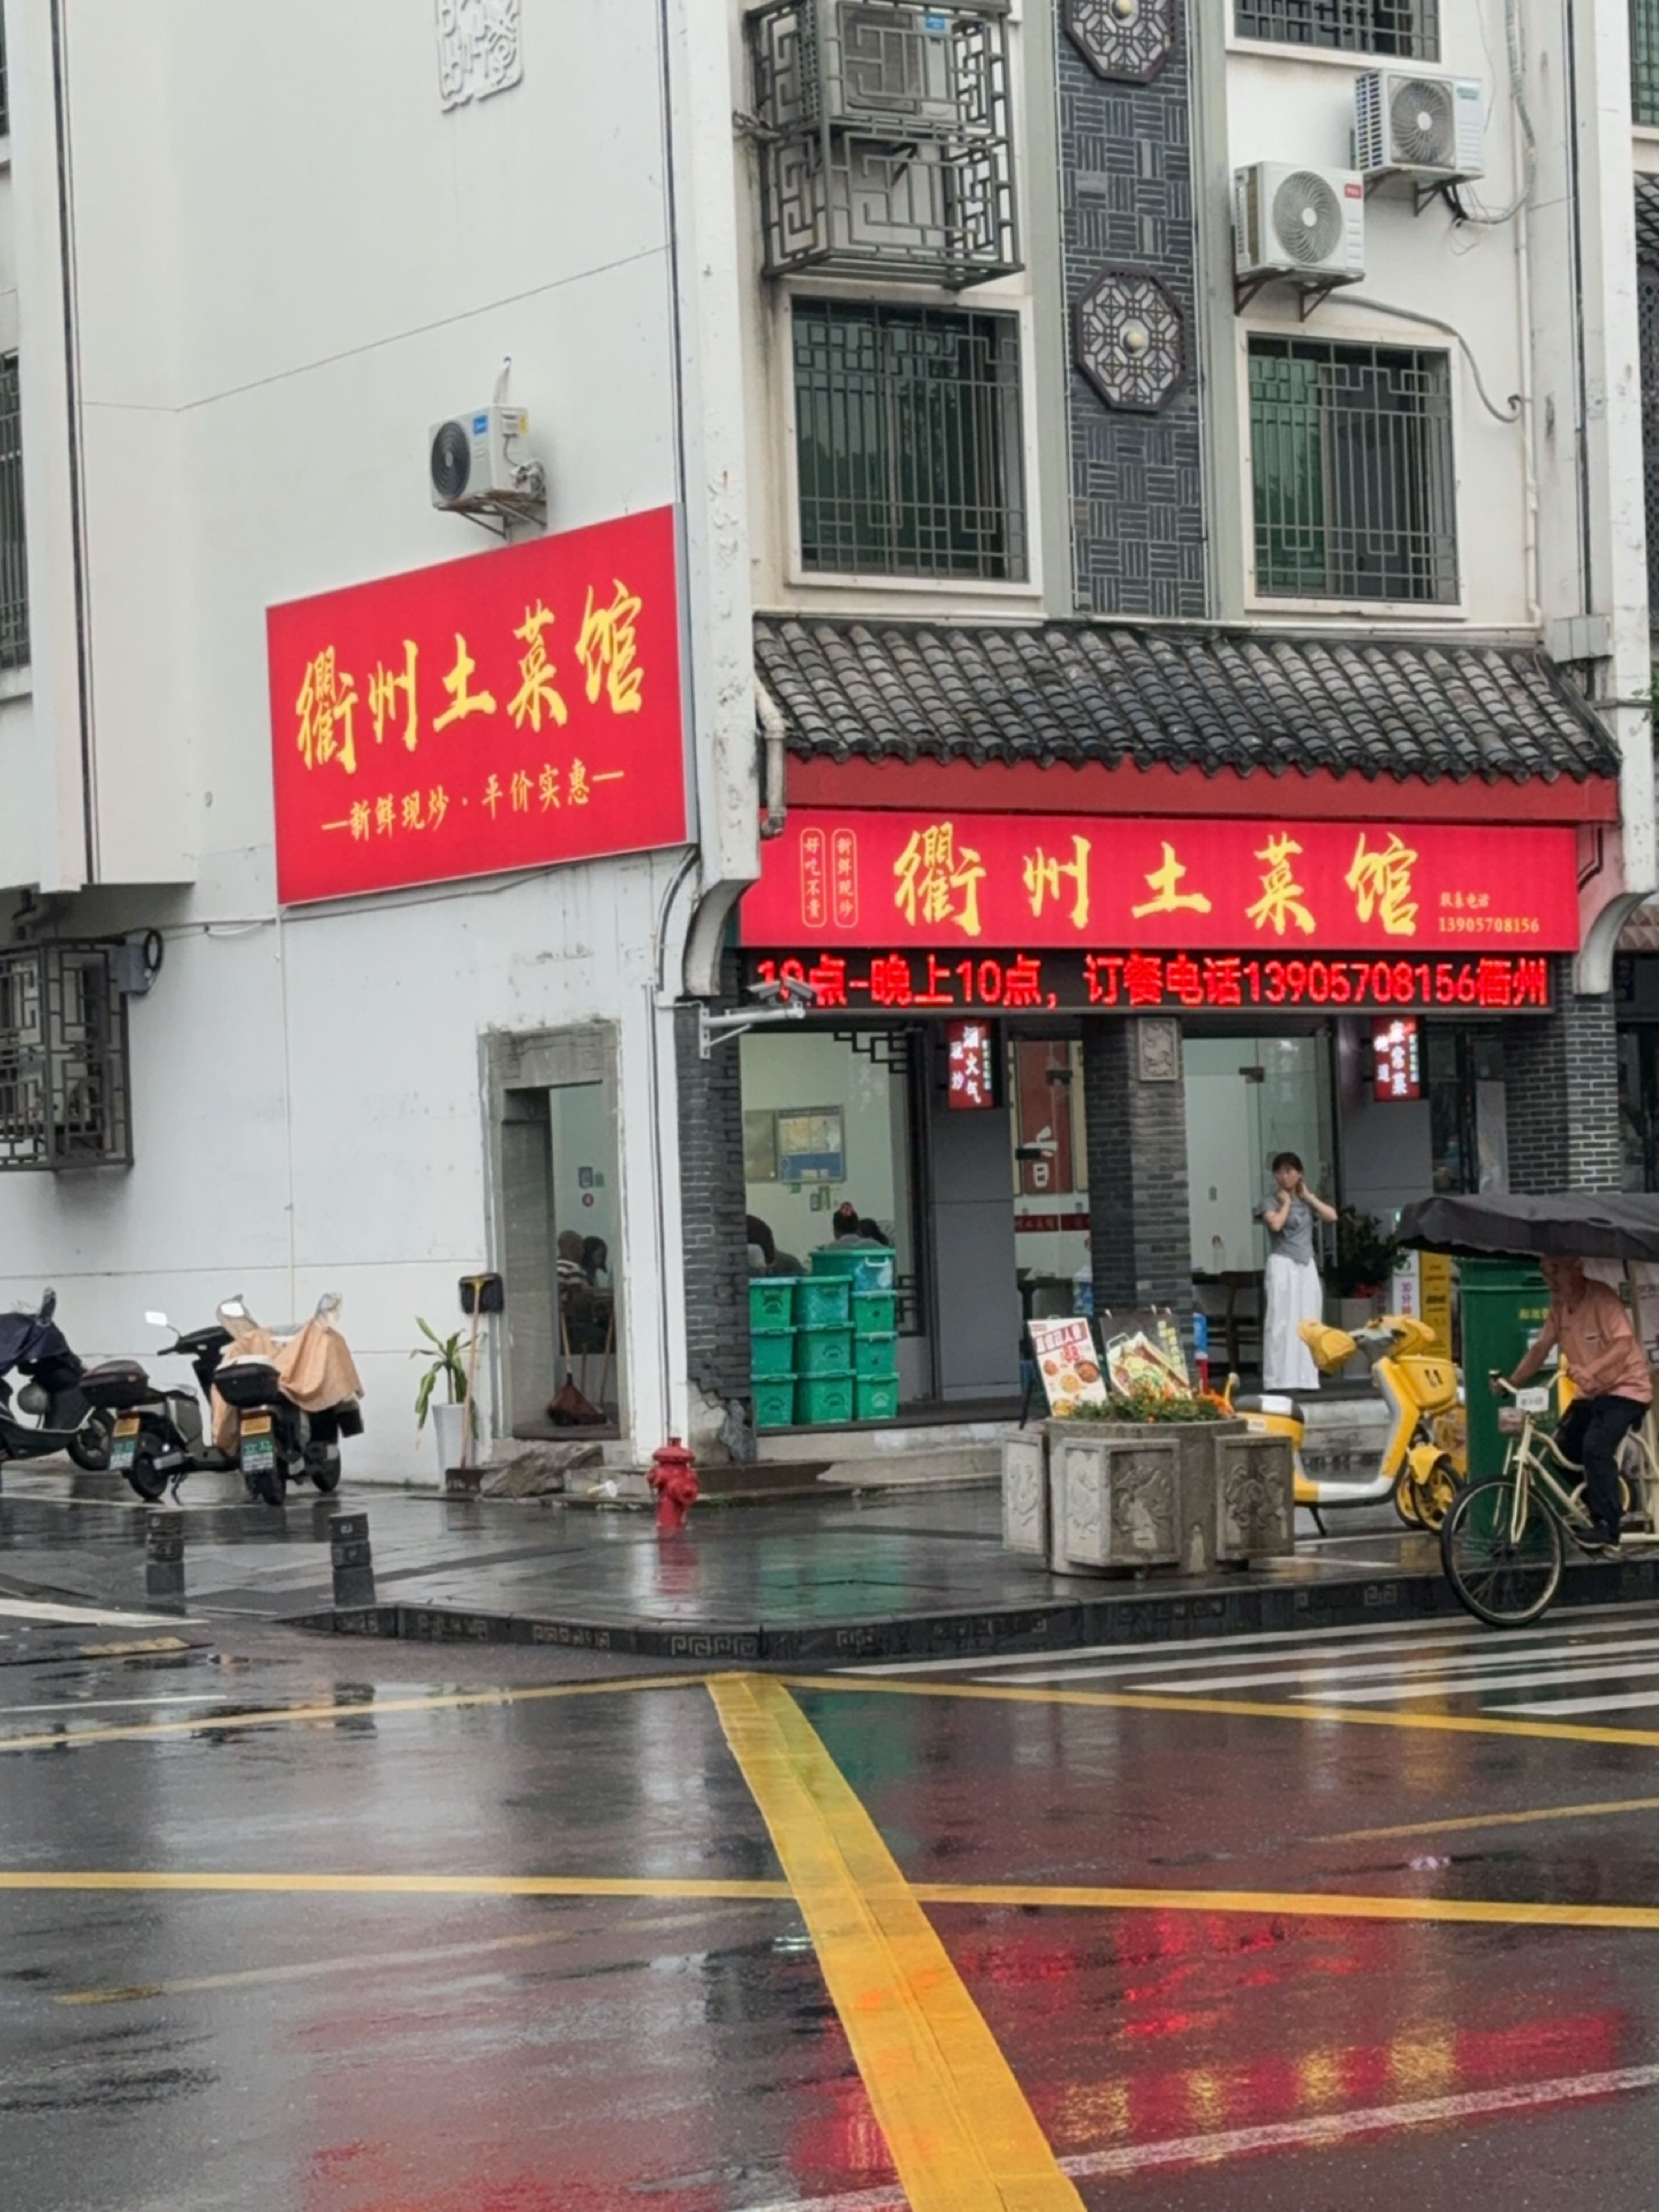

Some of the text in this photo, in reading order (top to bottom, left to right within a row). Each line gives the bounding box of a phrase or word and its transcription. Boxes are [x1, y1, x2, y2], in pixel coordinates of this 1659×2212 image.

[296, 579, 644, 773] 衢州土菜馆
[894, 822, 1419, 936] 衢州土菜馆
[1439, 917, 1539, 933] 13905708156
